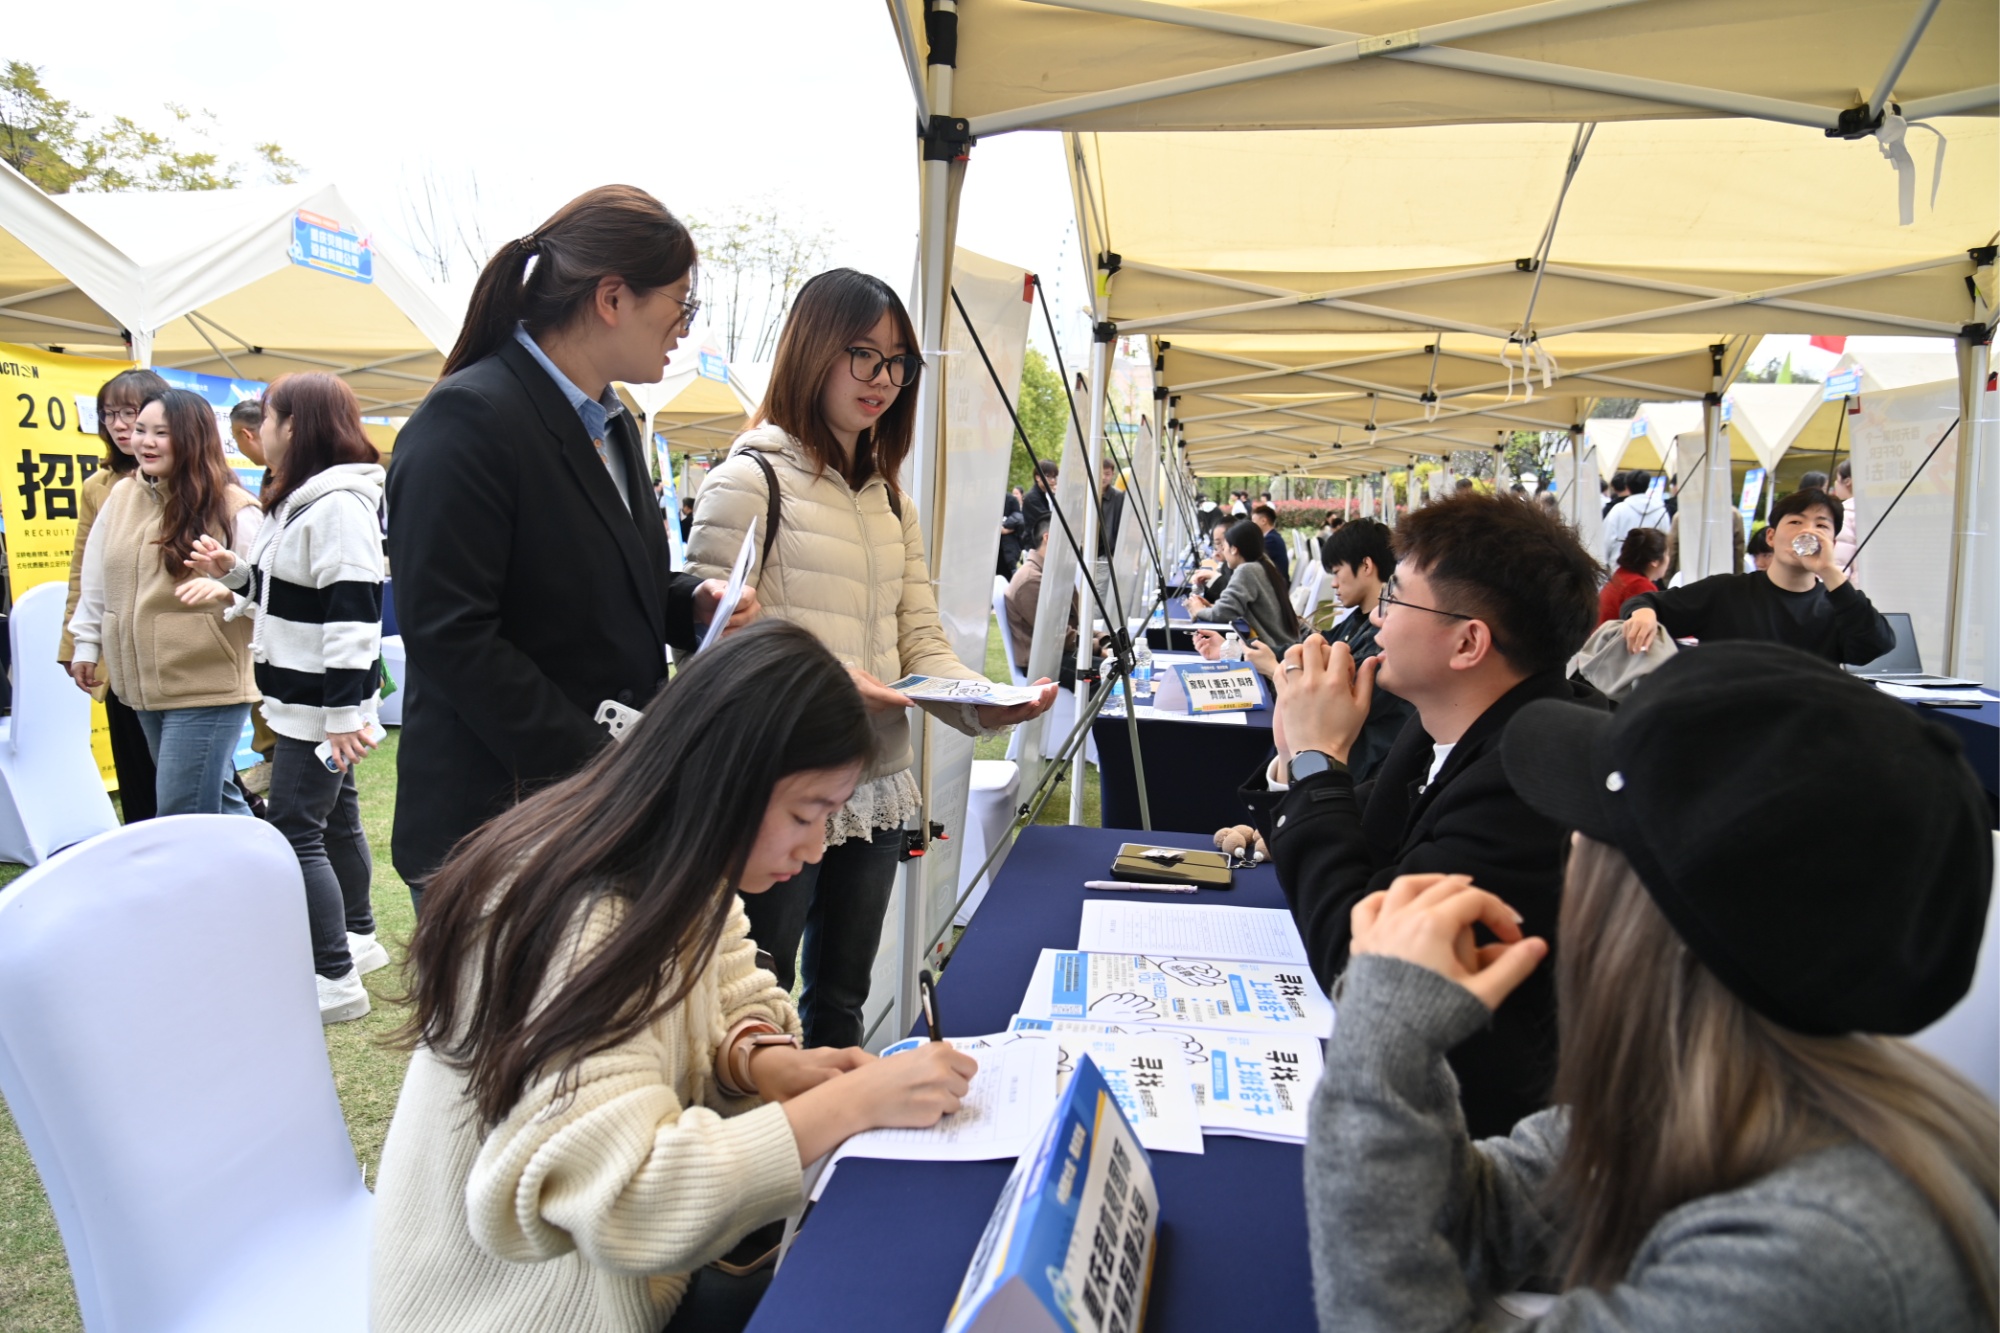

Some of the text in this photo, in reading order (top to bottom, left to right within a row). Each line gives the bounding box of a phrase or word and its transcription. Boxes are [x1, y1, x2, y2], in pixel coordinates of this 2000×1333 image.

[17, 393, 80, 432] 20
[1249, 980, 1291, 1021] 上班搭子
[1274, 974, 1307, 996] 寻找
[1130, 1056, 1165, 1087] 寻找
[1265, 1050, 1300, 1082] 寻找
[1234, 1057, 1274, 1116] 上班搭子
